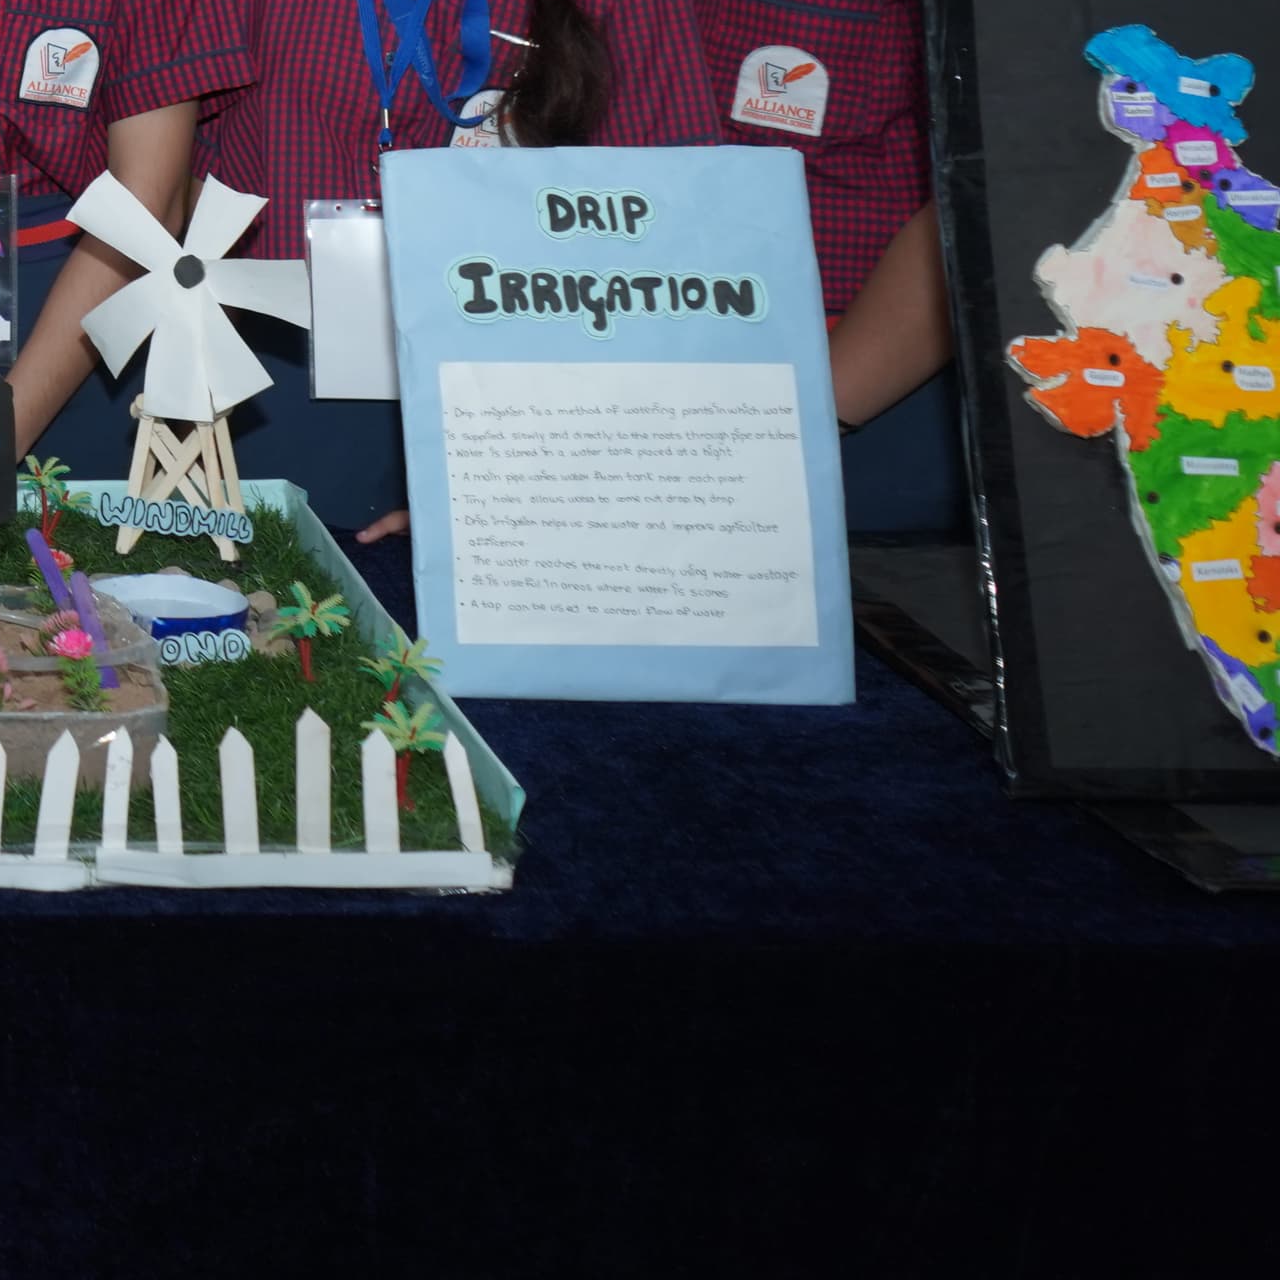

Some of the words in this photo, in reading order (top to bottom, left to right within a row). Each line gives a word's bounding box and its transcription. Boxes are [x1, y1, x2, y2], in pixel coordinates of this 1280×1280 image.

[26, 81, 88, 99] ALLIANCE
[743, 97, 817, 121] ALLIANCE
[546, 193, 649, 235] DRIP
[458, 262, 757, 331] IRRIGATION
[558, 406, 601, 416] method
[549, 430, 569, 441] and
[617, 431, 630, 440] to
[558, 449, 566, 458] a
[100, 492, 251, 540] WINDMILL
[471, 599, 480, 609] A
